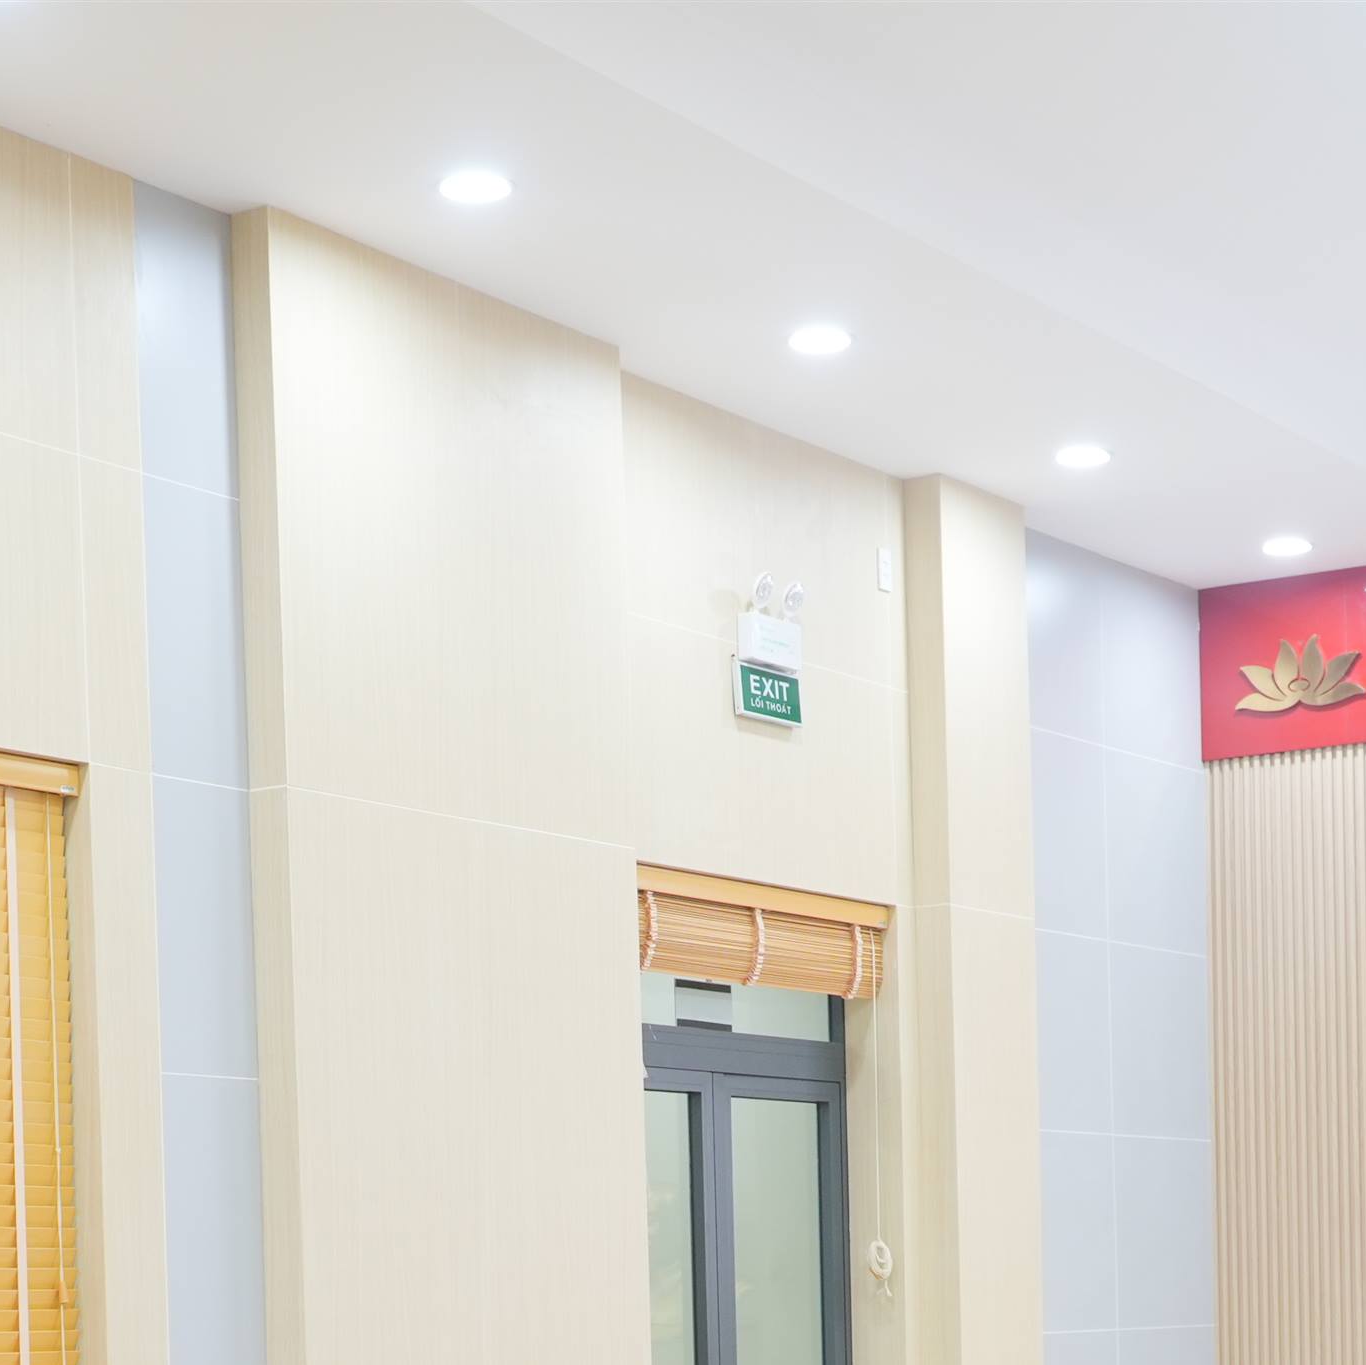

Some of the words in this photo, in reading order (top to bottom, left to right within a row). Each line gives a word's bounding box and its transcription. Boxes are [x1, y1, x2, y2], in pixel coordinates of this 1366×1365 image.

[749, 674, 790, 702] EXIT
[750, 695, 764, 709] LỐI
[765, 700, 792, 715] THOÁT
